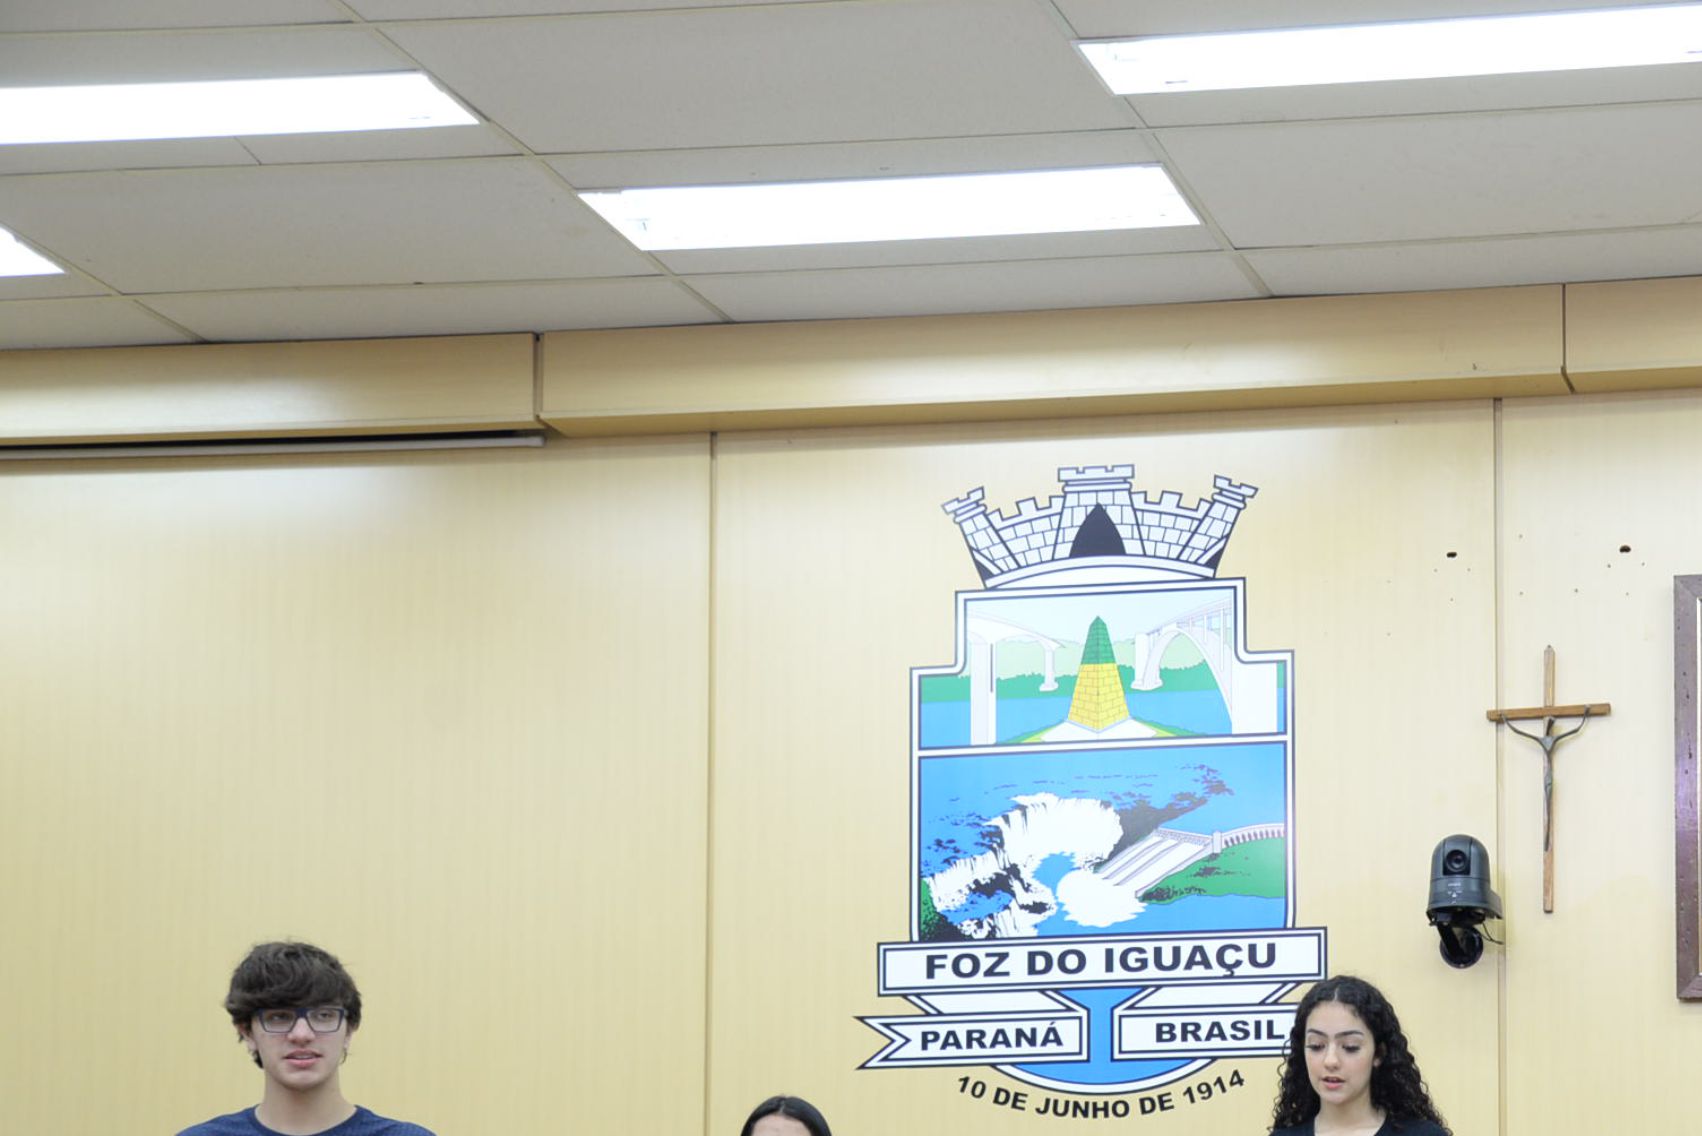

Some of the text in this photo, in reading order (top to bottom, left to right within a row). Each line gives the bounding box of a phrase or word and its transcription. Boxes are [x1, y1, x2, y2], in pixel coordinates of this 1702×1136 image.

[925, 942, 1278, 979] FOZ DO IGUAÇU
[920, 1021, 1064, 1051] PARANÁ
[1154, 1018, 1286, 1043] BRASIL
[958, 1068, 1245, 1119] 10 DE JUNHO DE 1914
